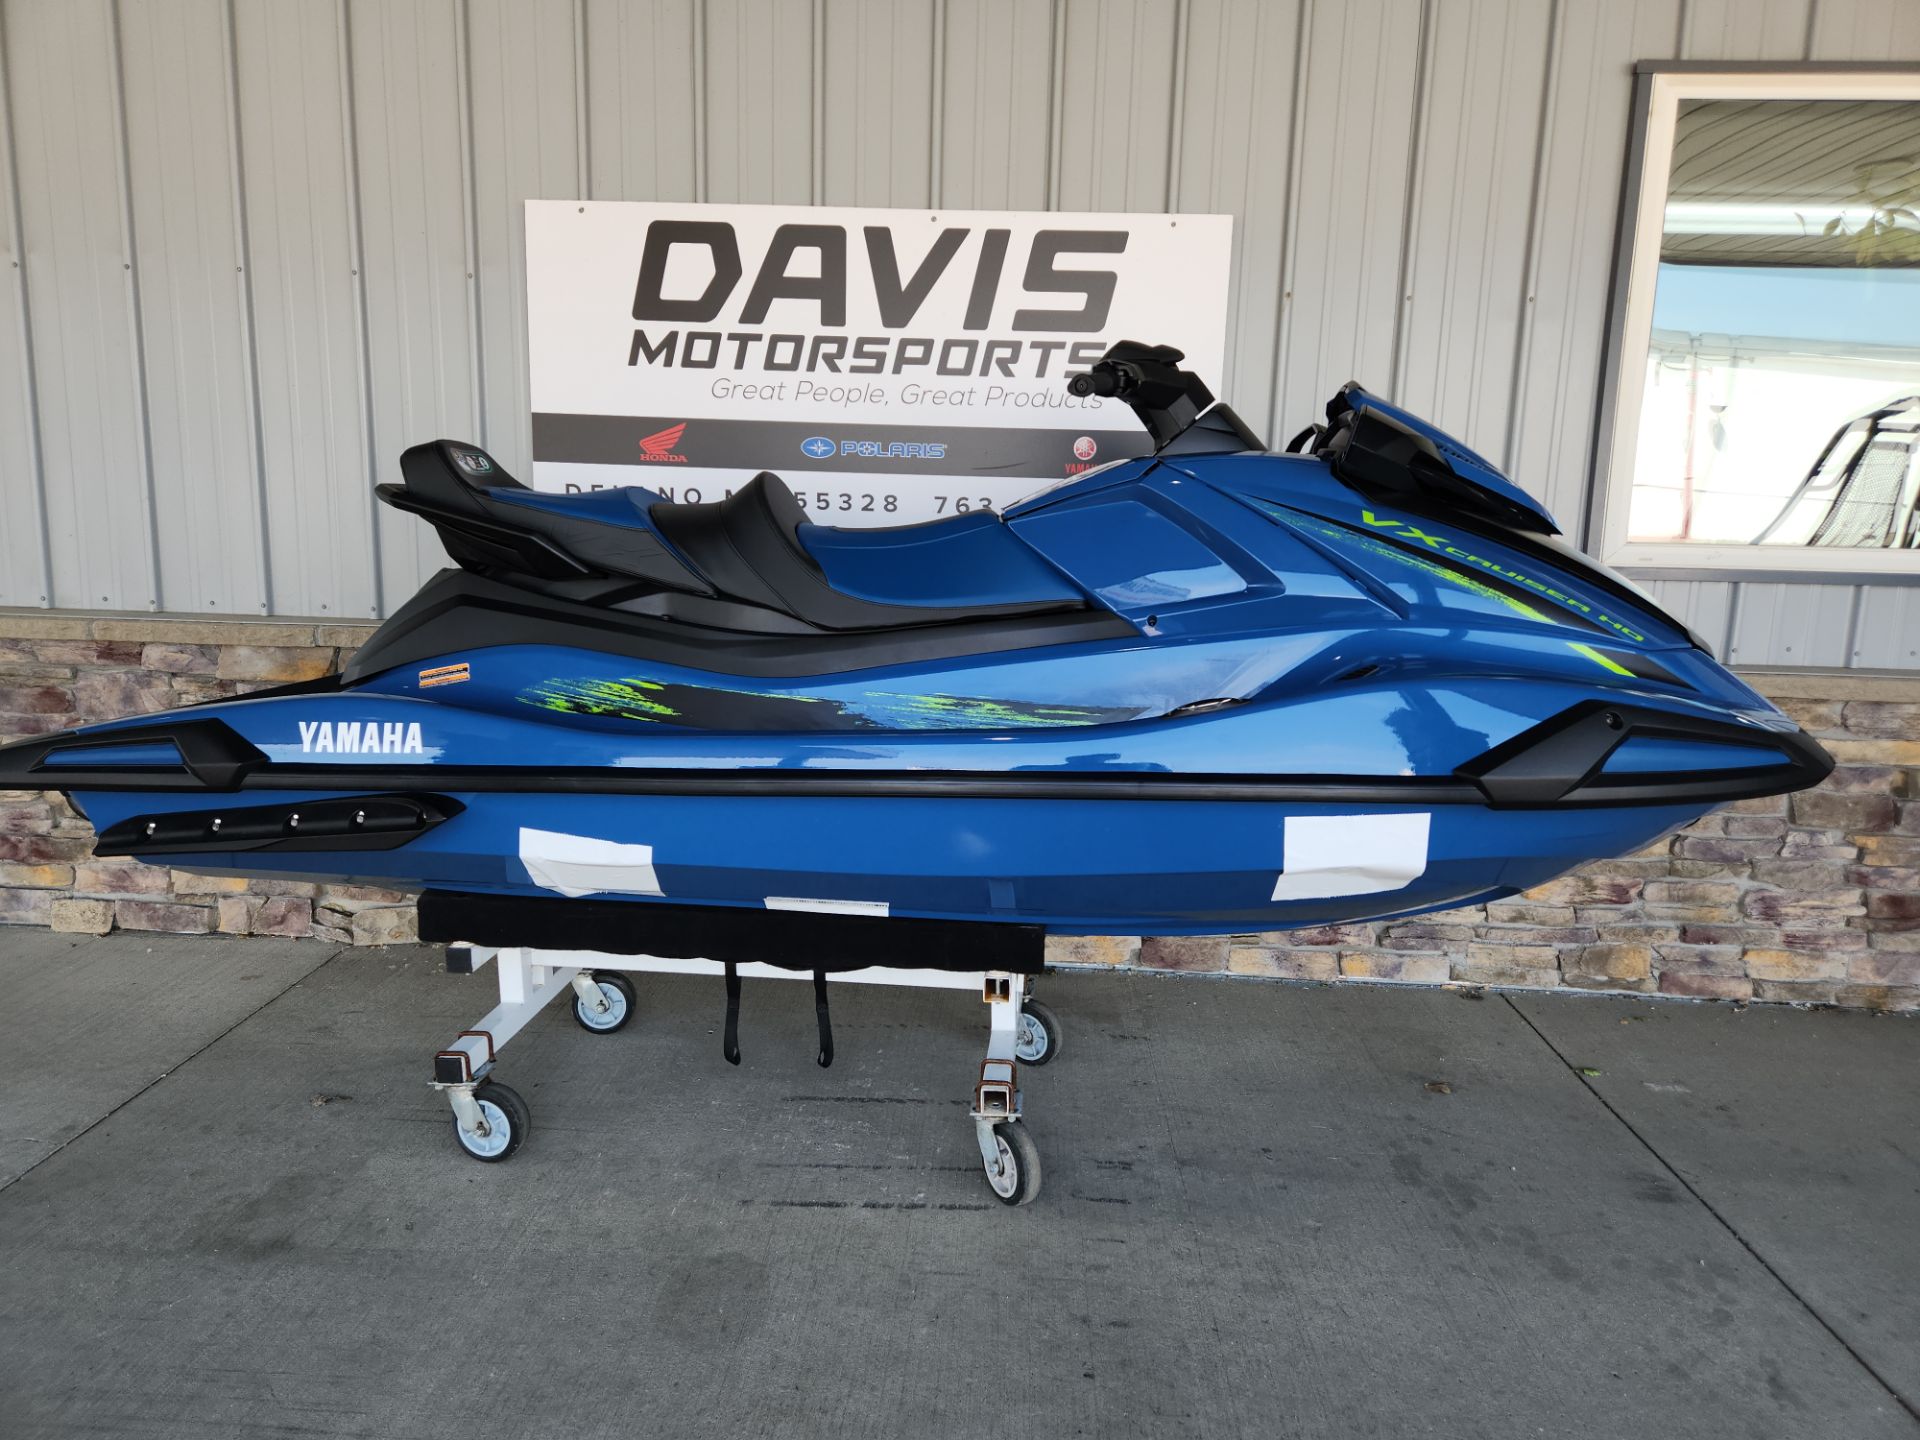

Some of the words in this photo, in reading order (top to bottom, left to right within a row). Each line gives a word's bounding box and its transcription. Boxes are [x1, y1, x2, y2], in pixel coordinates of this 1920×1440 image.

[632, 220, 1130, 333] DAVIS
[628, 329, 1107, 379] MOTORSPORTS
[711, 378, 786, 402] Great
[794, 380, 889, 408] People,
[900, 383, 976, 407] Great
[984, 386, 1104, 409] Products
[639, 453, 689, 464] HONDA
[840, 440, 946, 459] POLARIS
[793, 491, 898, 512] 55328
[1362, 510, 1448, 548] VX
[1444, 546, 1591, 613] CRUISER
[1599, 614, 1644, 642] HO
[298, 720, 424, 754] YAMAHA
